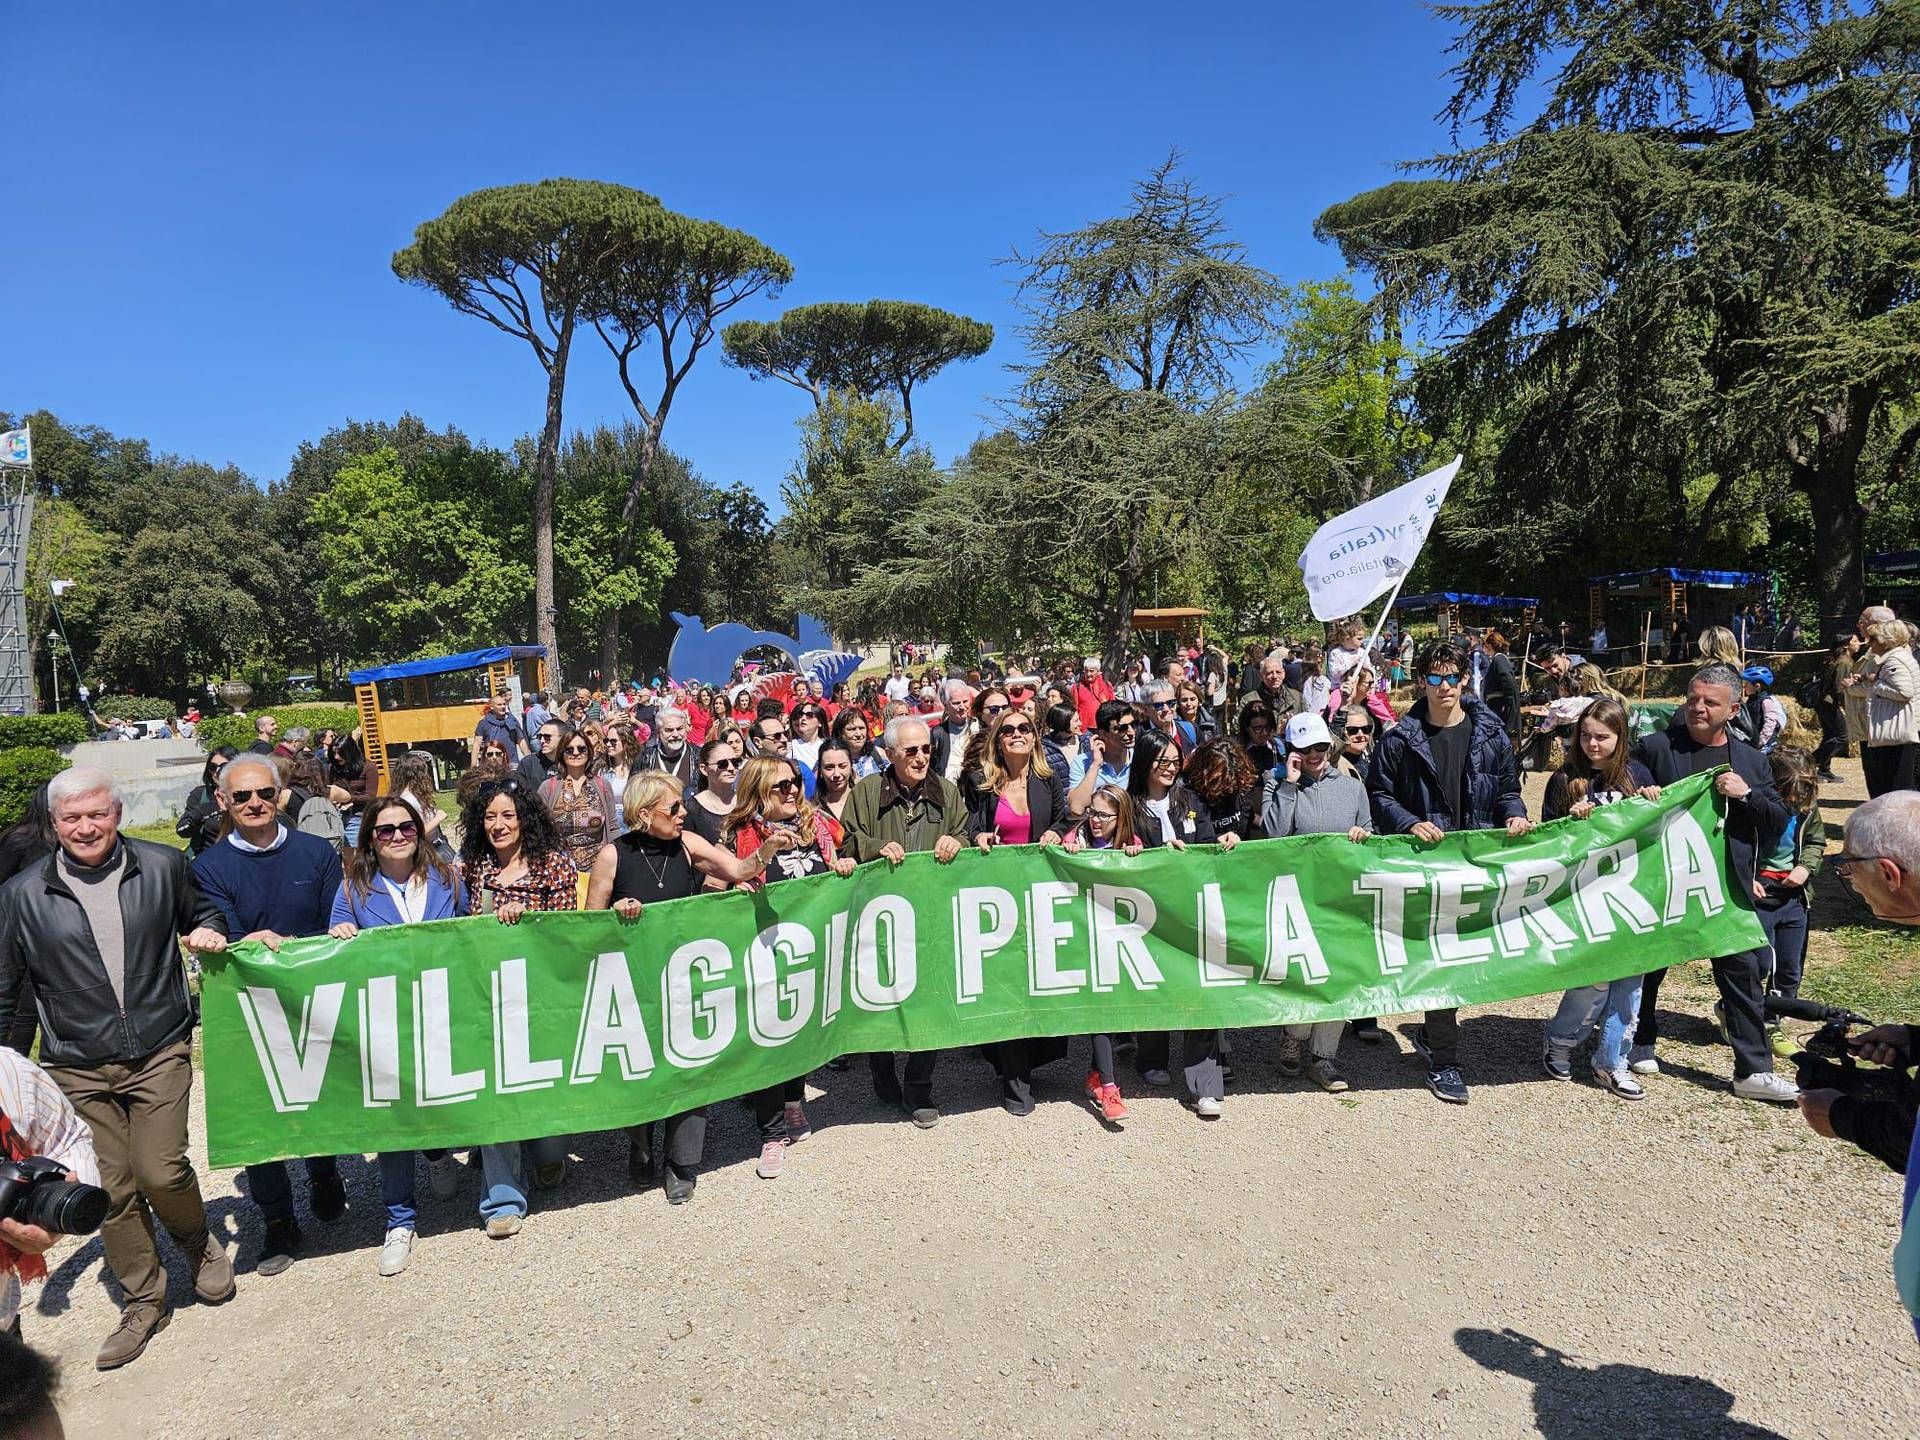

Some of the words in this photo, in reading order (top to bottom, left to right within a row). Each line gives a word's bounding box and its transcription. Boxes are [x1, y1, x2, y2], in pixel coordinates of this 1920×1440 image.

[237, 894, 918, 1113] VILLAGGIO
[953, 880, 1165, 1004] PER
[1197, 874, 1331, 987] LA
[1352, 807, 1725, 976] TERRA
